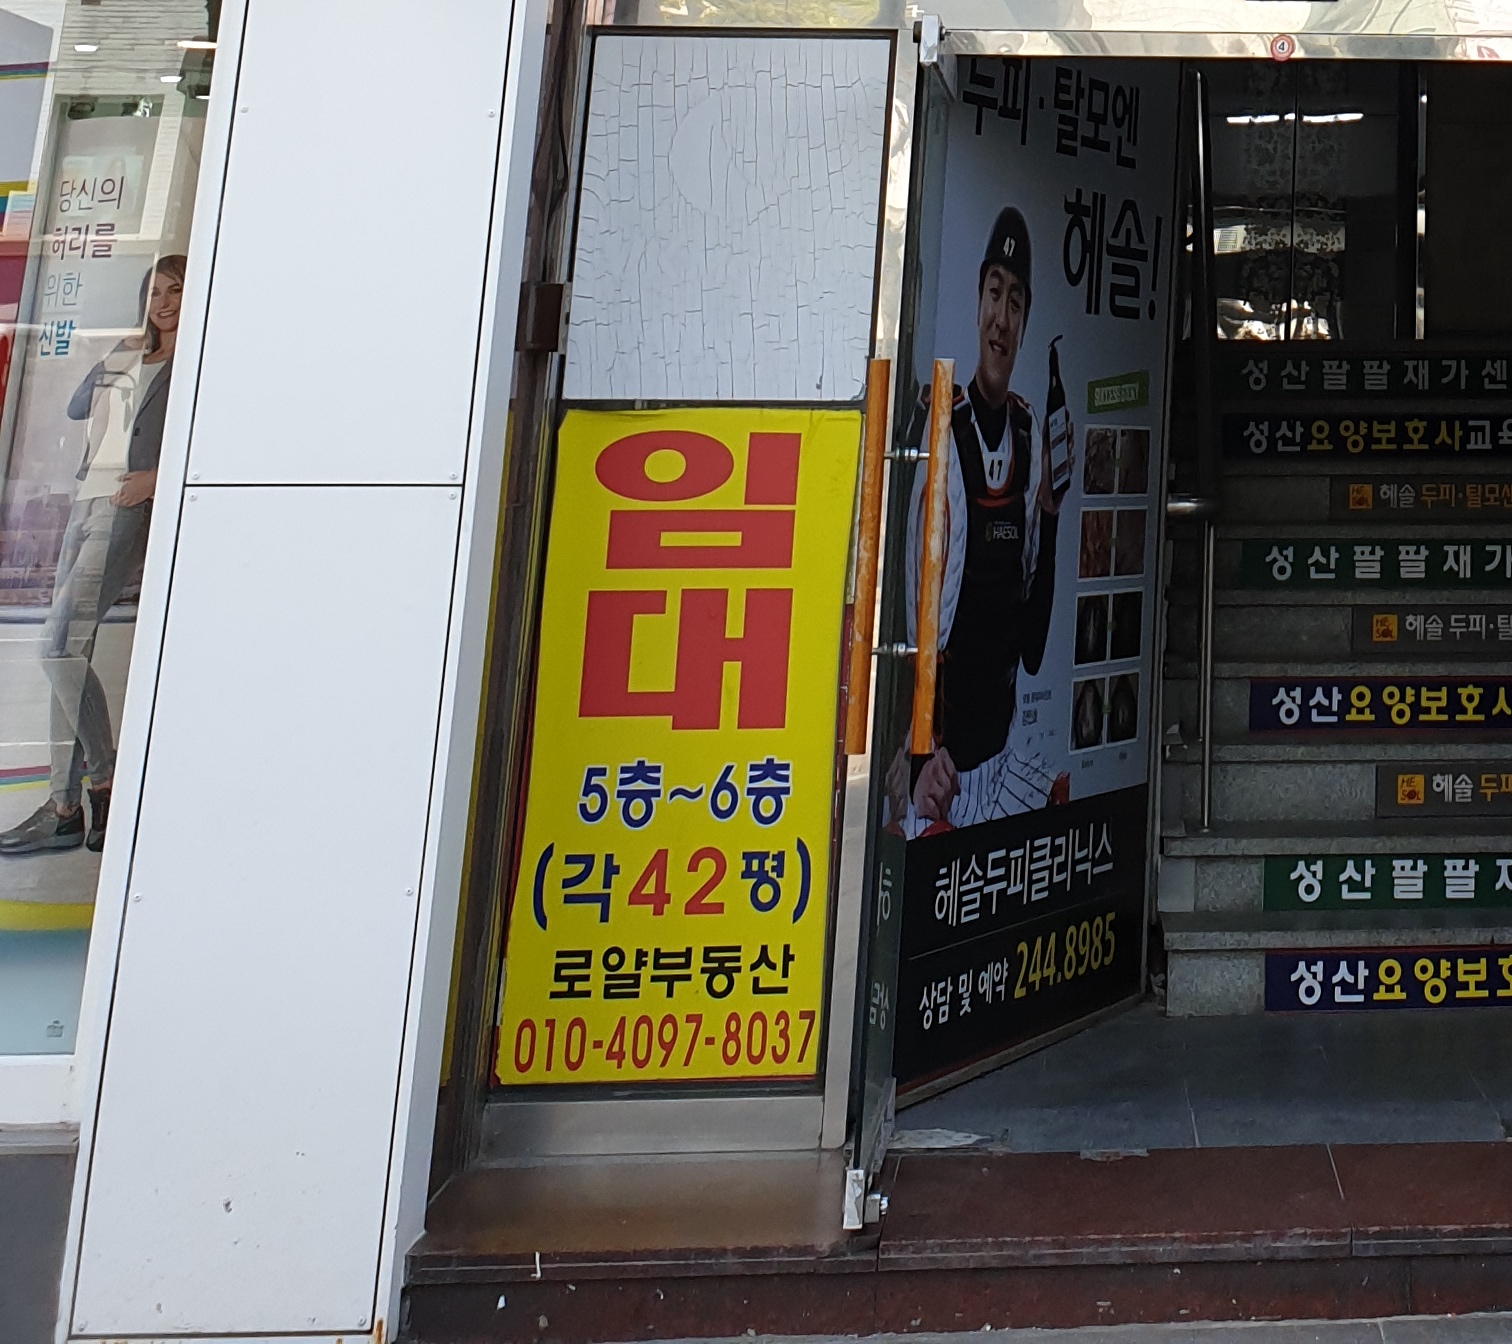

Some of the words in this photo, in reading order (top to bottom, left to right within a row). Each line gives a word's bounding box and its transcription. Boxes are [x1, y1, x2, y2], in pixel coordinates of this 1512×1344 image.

[59, 175, 125, 213] 당신의
[51, 223, 118, 261] 허리를
[1062, 188, 1162, 321] 헤솔!
[44, 272, 84, 308] 위한
[38, 320, 77, 357] 신발
[1380, 483, 1416, 508] 헤솔
[578, 430, 802, 731] 임대
[1405, 614, 1444, 641] 헤솔
[577, 755, 792, 830] 5층~6층
[1432, 772, 1473, 803] 헤솔
[934, 821, 1114, 928] 헤솔두피클리닉스
[548, 942, 796, 1001] 로얄부동산
[918, 984, 953, 1031] 상담
[957, 967, 974, 1018] 및
[978, 957, 1009, 1008] 예약
[1013, 912, 1117, 1000] 244.8985
[513, 1009, 817, 1073] 010-4097-8037
